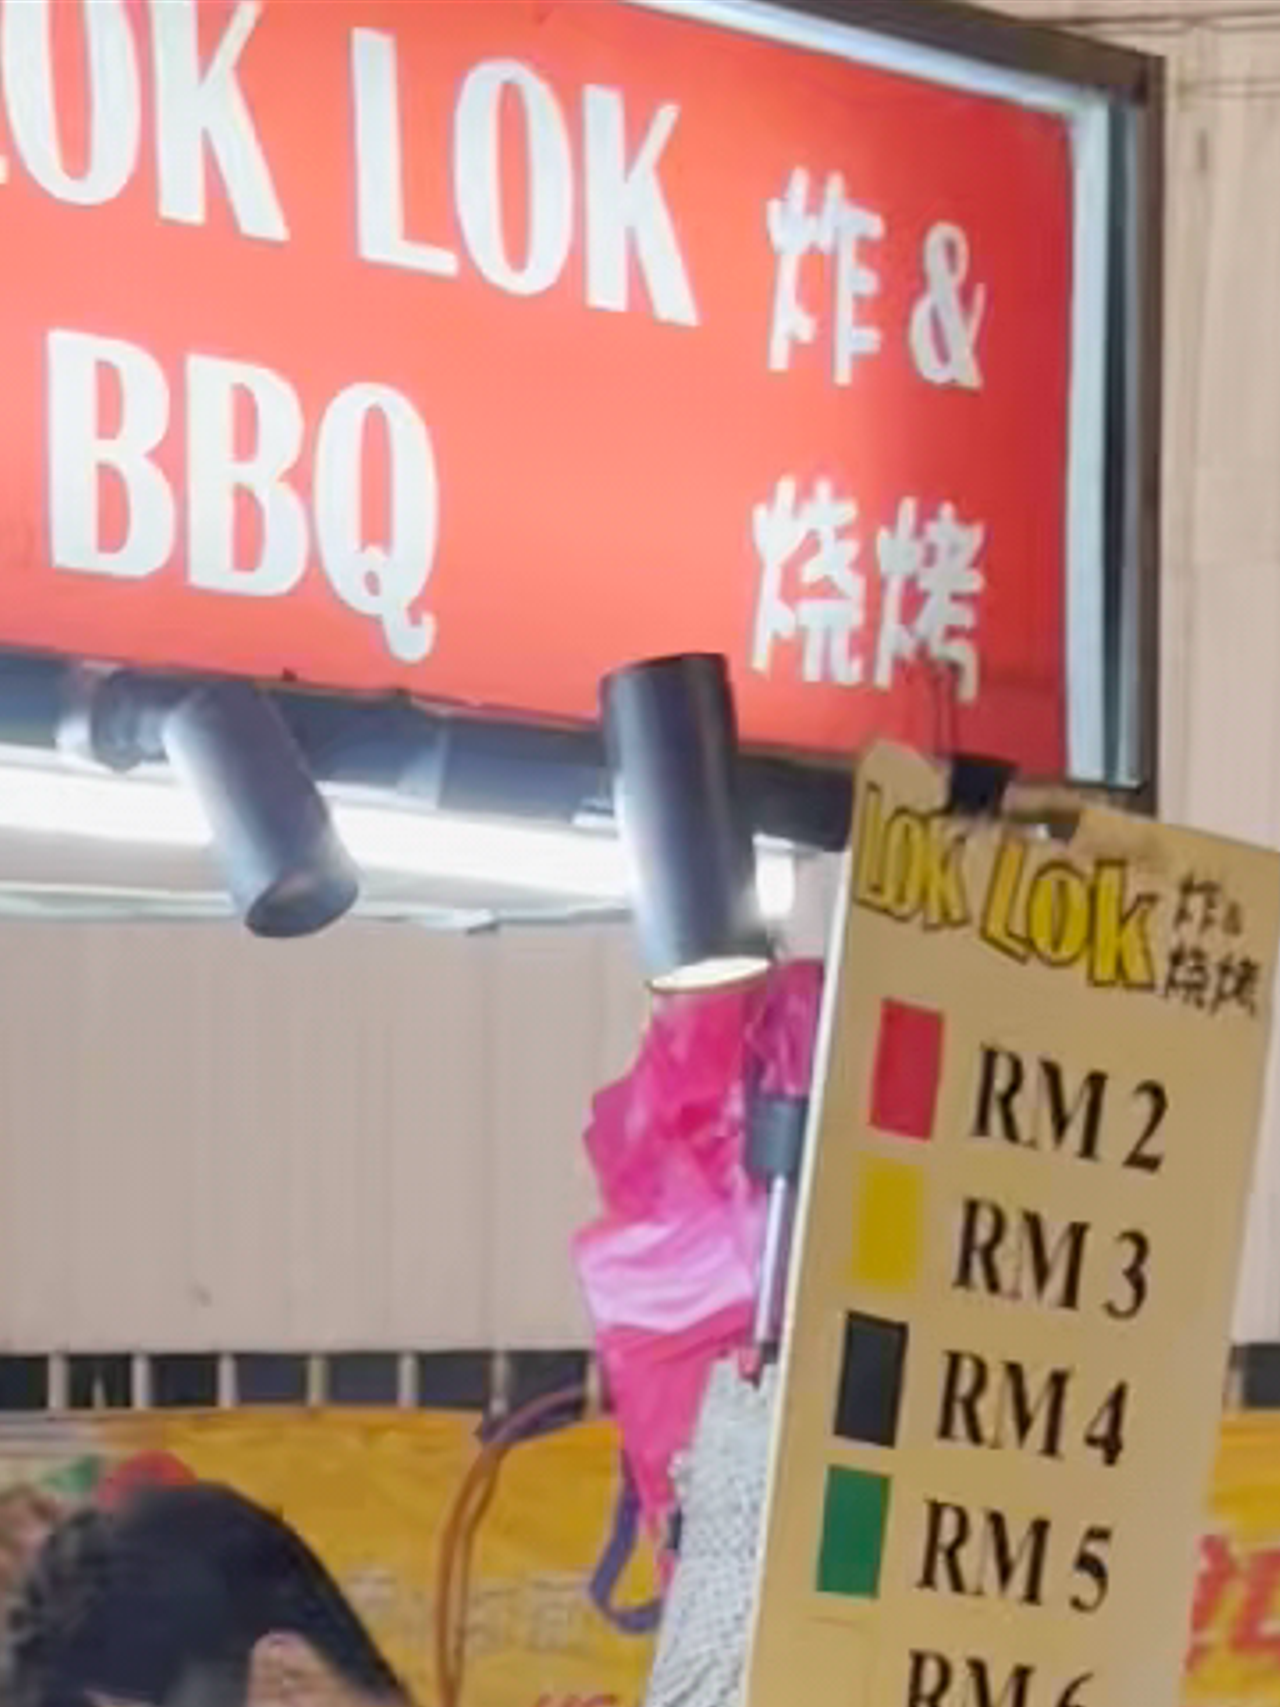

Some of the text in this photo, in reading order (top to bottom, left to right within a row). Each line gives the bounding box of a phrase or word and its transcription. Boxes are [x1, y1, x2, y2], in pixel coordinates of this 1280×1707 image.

[352, 26, 699, 327] LOK
[48, 328, 439, 664] BBQ
[751, 478, 985, 704] 烧烤
[853, 781, 1161, 991] LOK LOK
[971, 1042, 1169, 1174] RM 2
[952, 1196, 1150, 1320] RM 3
[936, 1349, 1129, 1466] RM 4
[916, 1499, 1113, 1613] RM 5
